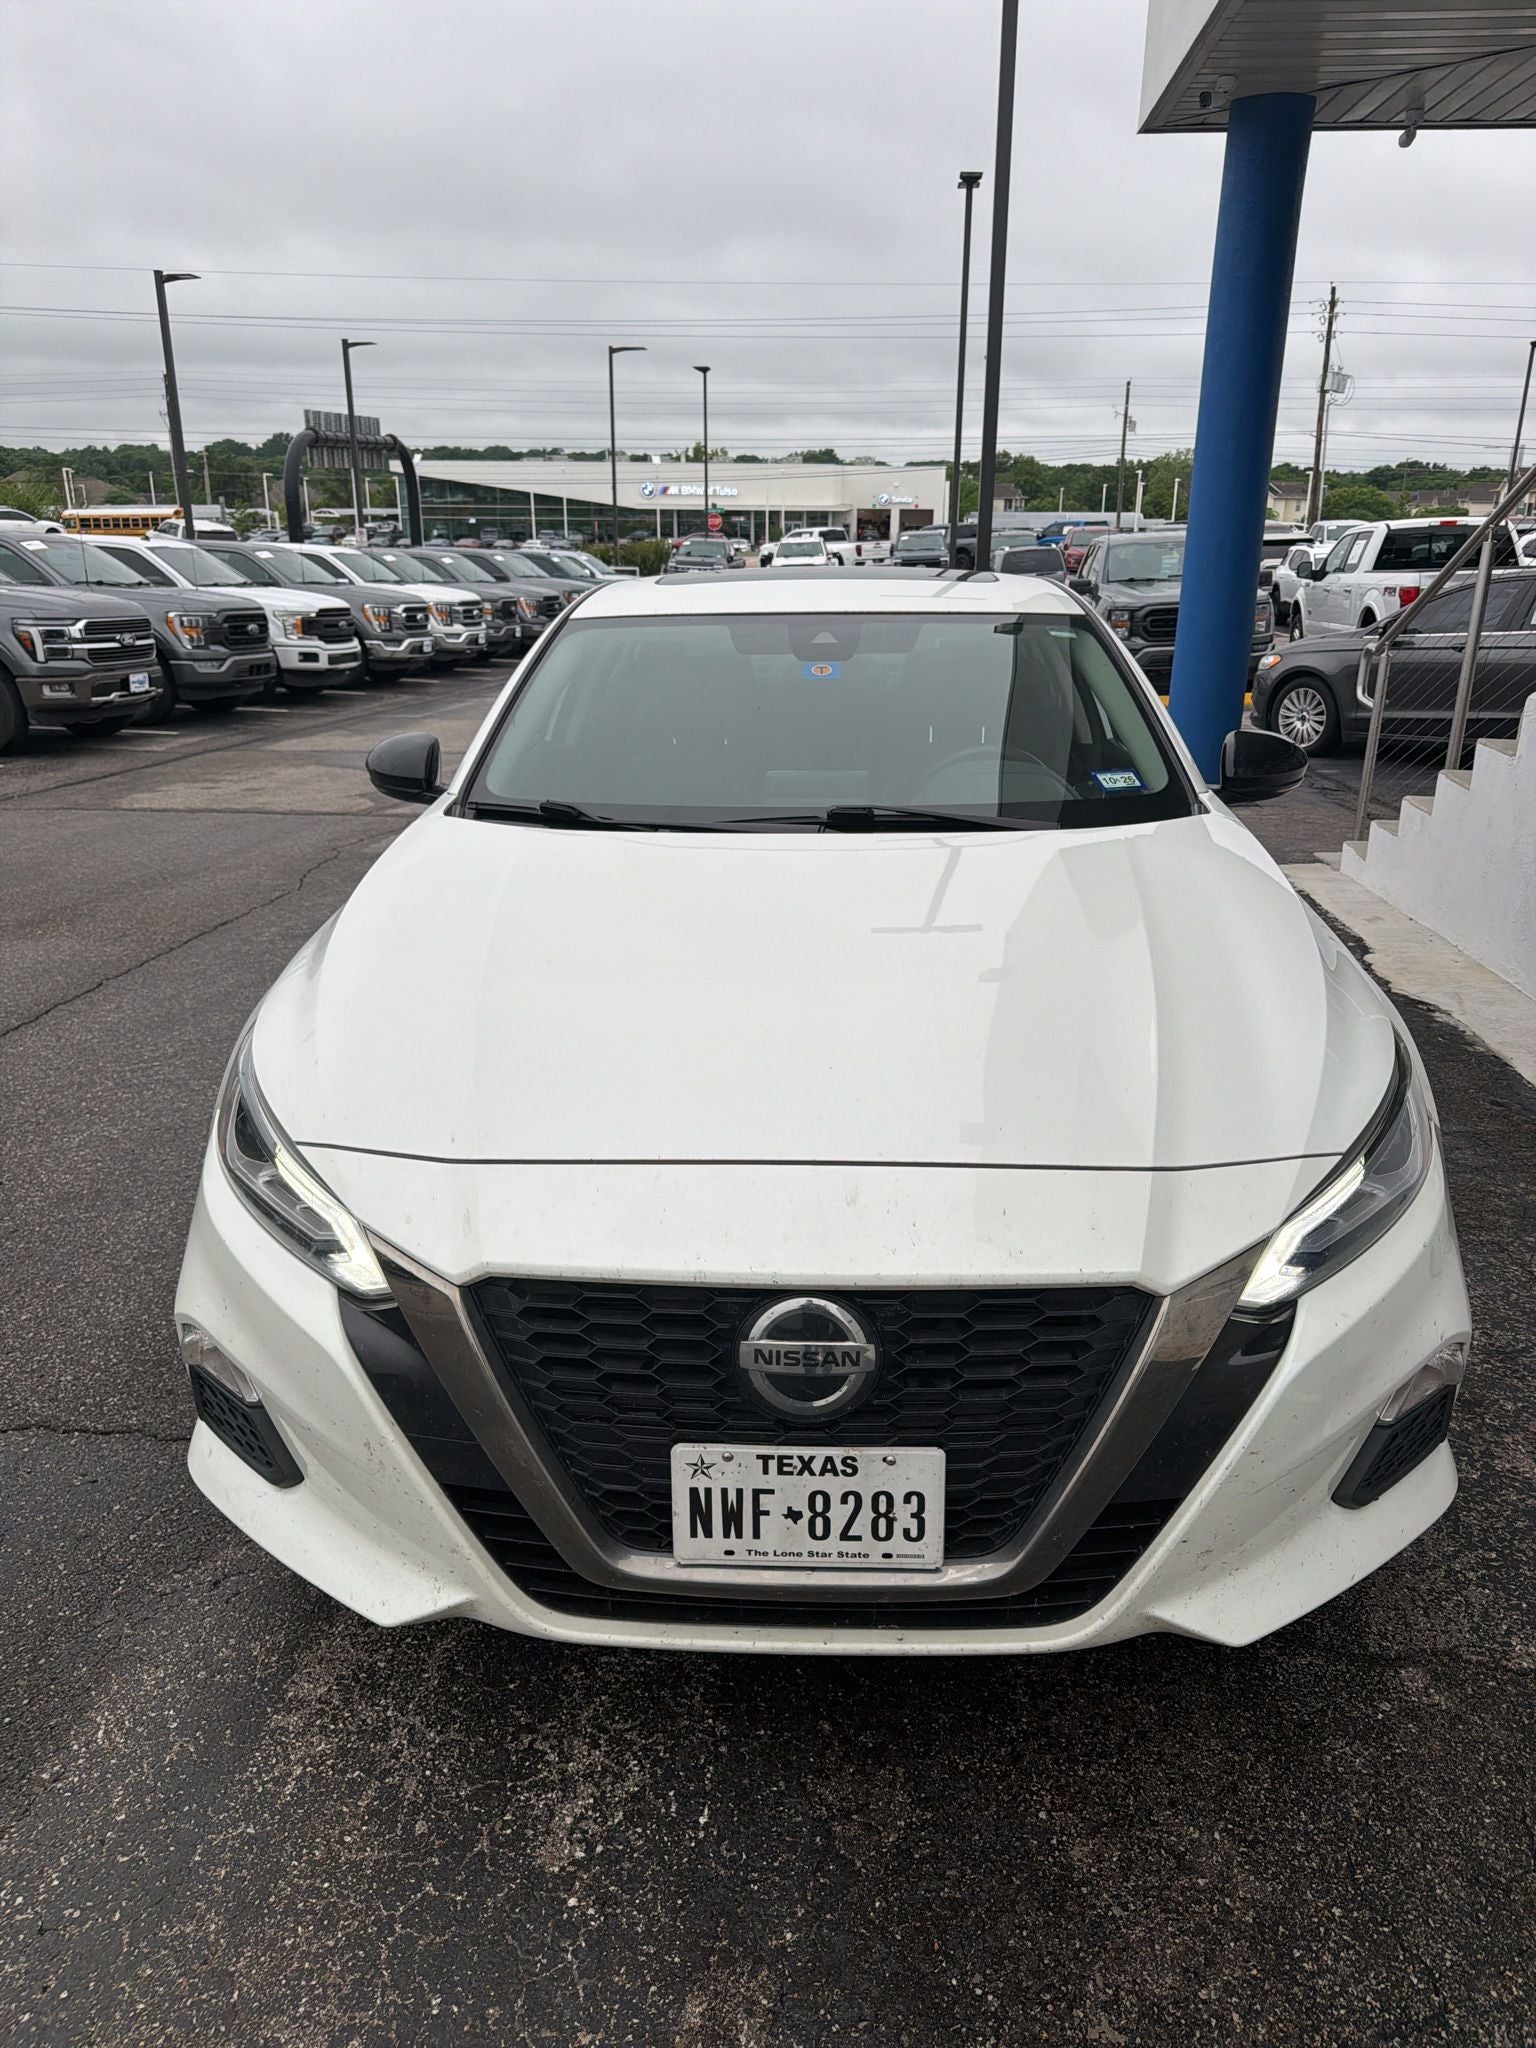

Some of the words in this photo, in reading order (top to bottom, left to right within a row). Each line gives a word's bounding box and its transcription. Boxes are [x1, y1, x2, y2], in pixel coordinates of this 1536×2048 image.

[681, 485, 705, 496] BMW
[716, 486, 738, 496] Tulsa
[1102, 777, 1117, 785] 10
[753, 1348, 861, 1368] NISSAN
[756, 1454, 859, 1478] TEXAS
[689, 1486, 775, 1540] NWF
[807, 1489, 926, 1543] 8283
[745, 1549, 769, 1557] The
[773, 1550, 803, 1558] Lone
[807, 1550, 833, 1559] Star
[836, 1551, 870, 1560] State
